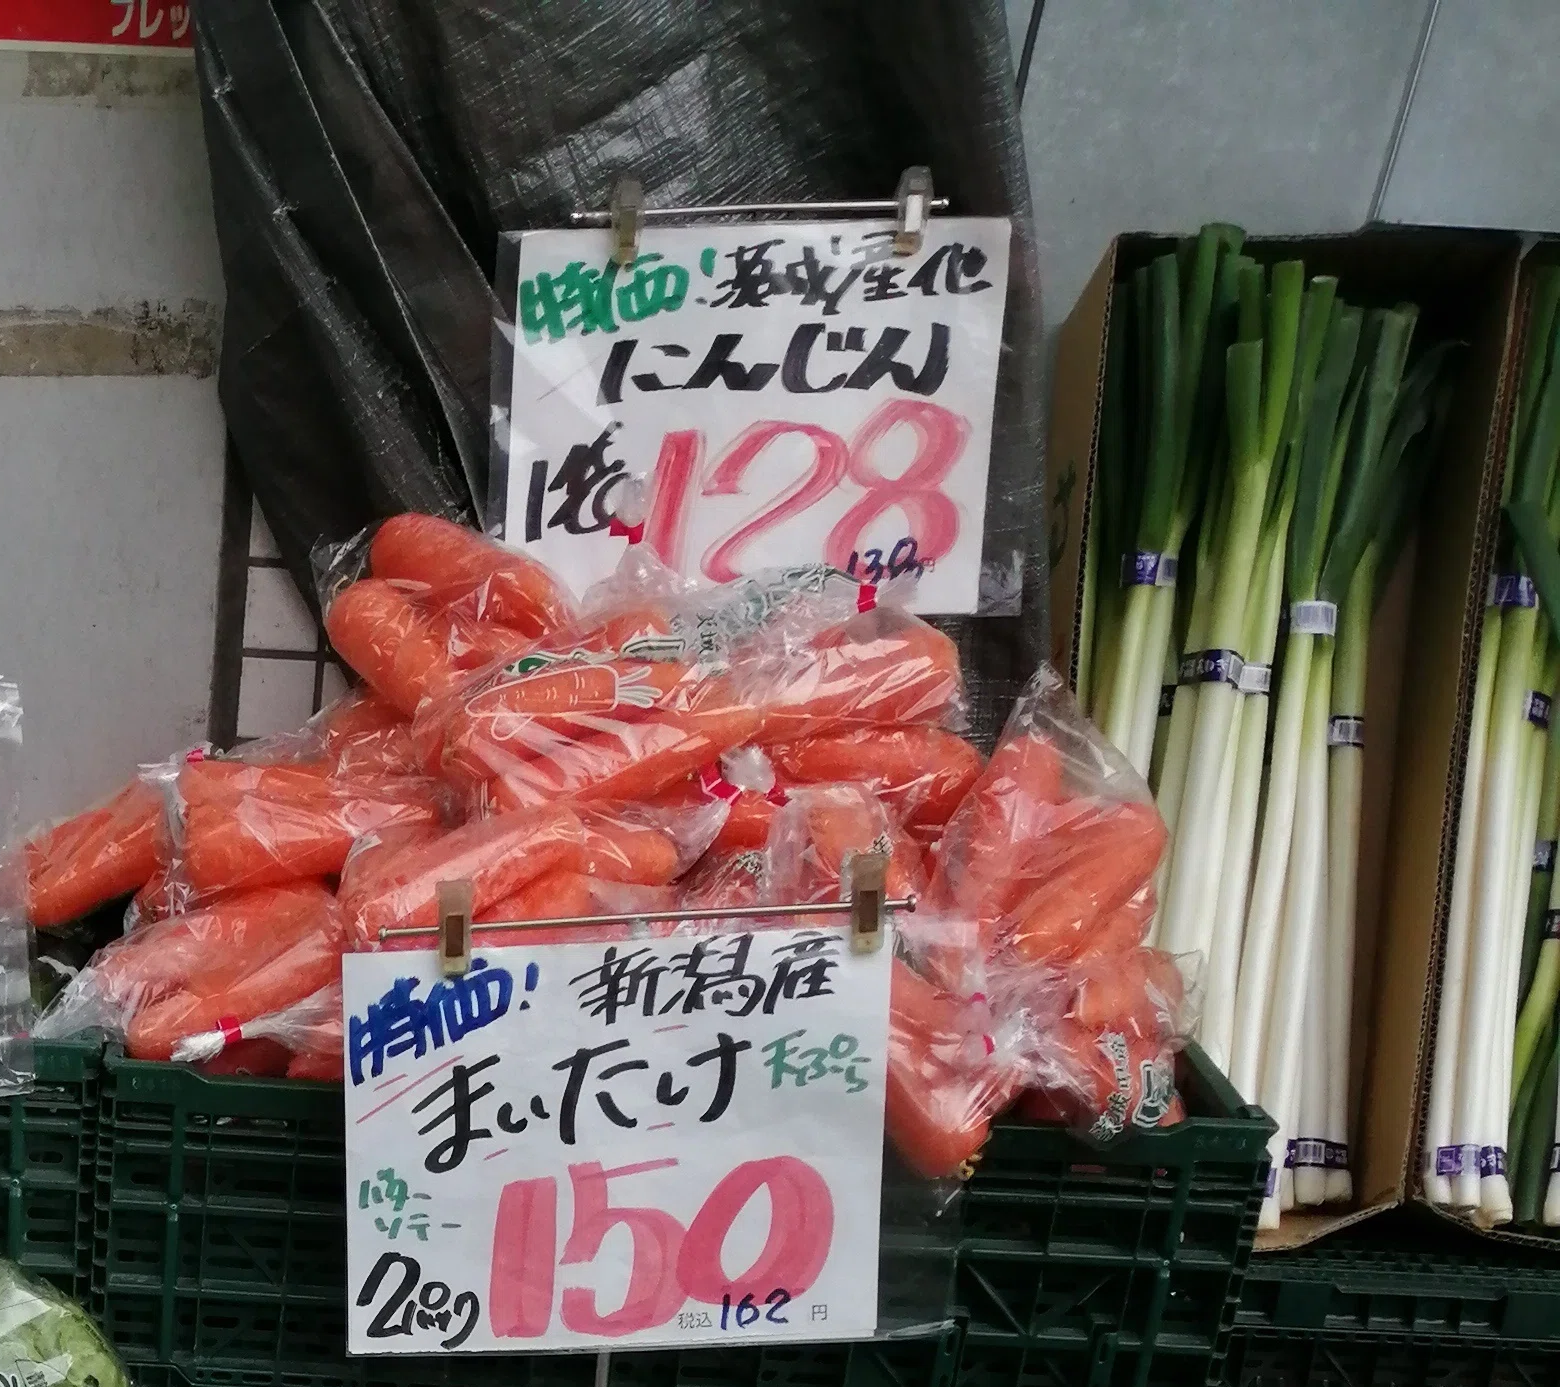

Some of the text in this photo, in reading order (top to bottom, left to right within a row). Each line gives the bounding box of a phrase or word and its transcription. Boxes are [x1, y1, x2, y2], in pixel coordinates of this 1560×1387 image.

[596, 322, 952, 406] にんじん
[644, 397, 975, 584] 128
[569, 931, 845, 1025] 新潟産
[411, 1032, 753, 1174] まいたけ
[489, 1155, 836, 1338] 150
[719, 1287, 791, 1331] 162
